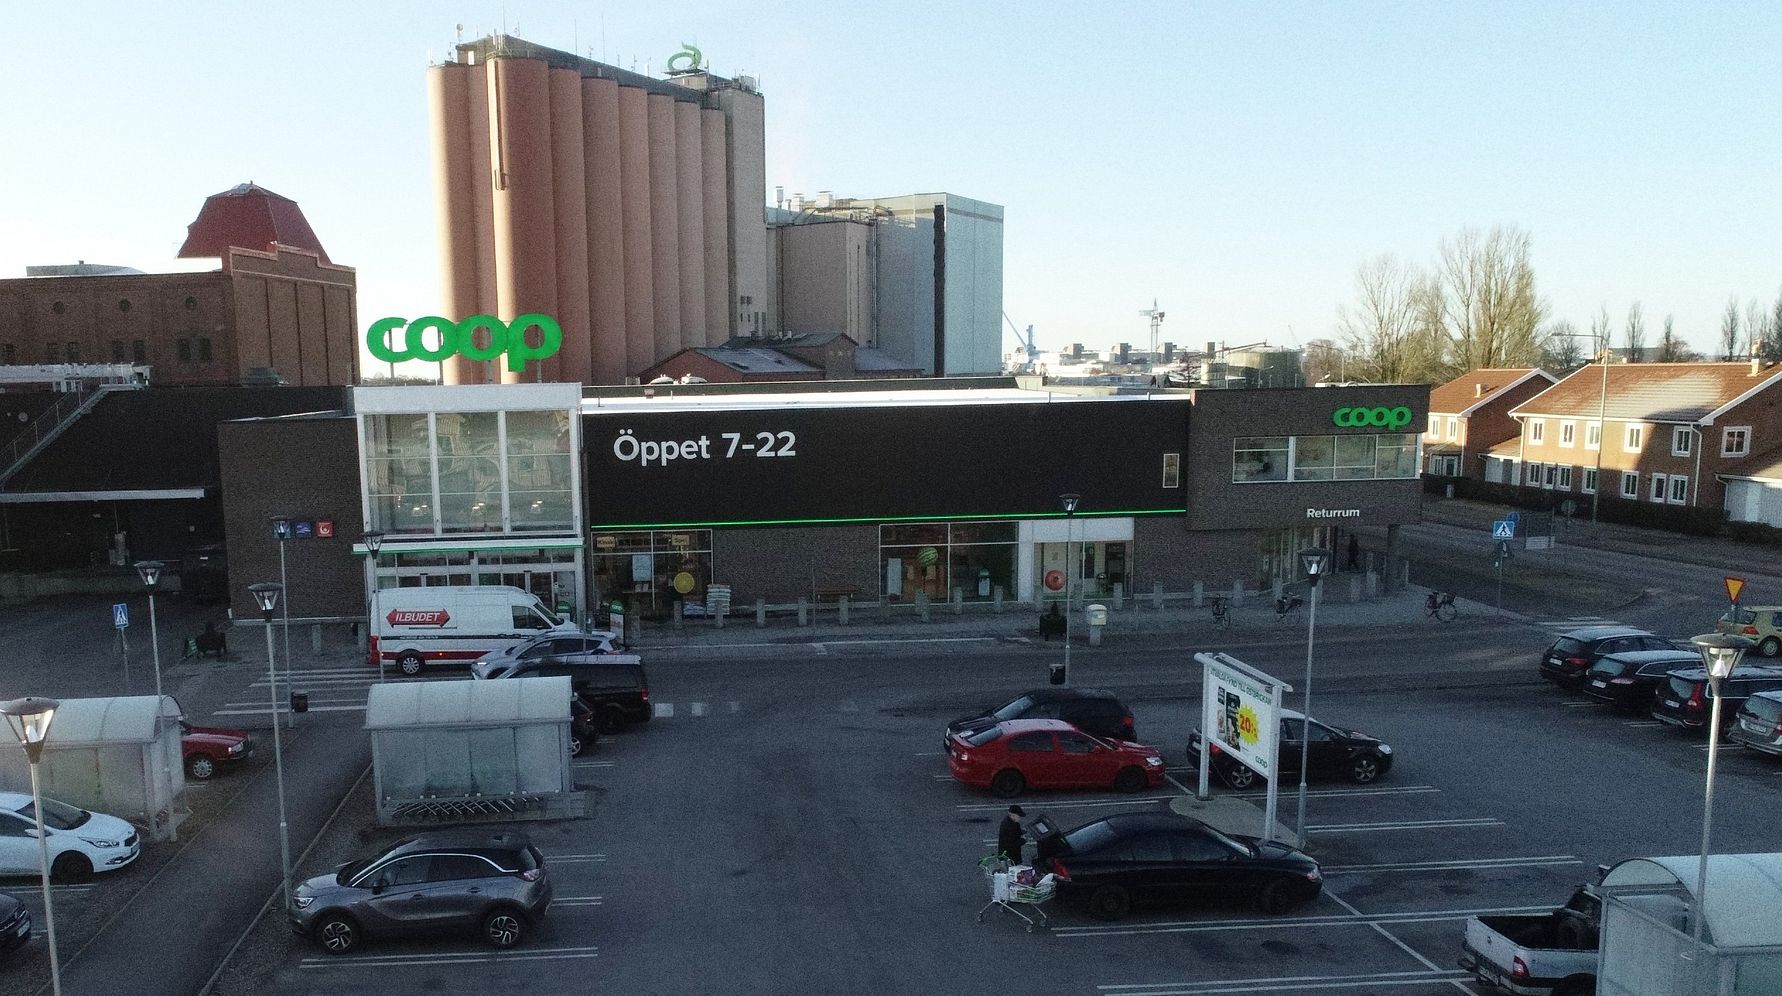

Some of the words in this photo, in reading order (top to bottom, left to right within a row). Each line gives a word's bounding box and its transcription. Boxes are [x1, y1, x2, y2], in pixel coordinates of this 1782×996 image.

[367, 313, 563, 372] coop
[1333, 406, 1412, 431] coop
[613, 428, 711, 466] Öppet
[721, 430, 796, 458] 7-22
[1306, 508, 1360, 518] Returrum
[395, 612, 441, 622] ILBUDET
